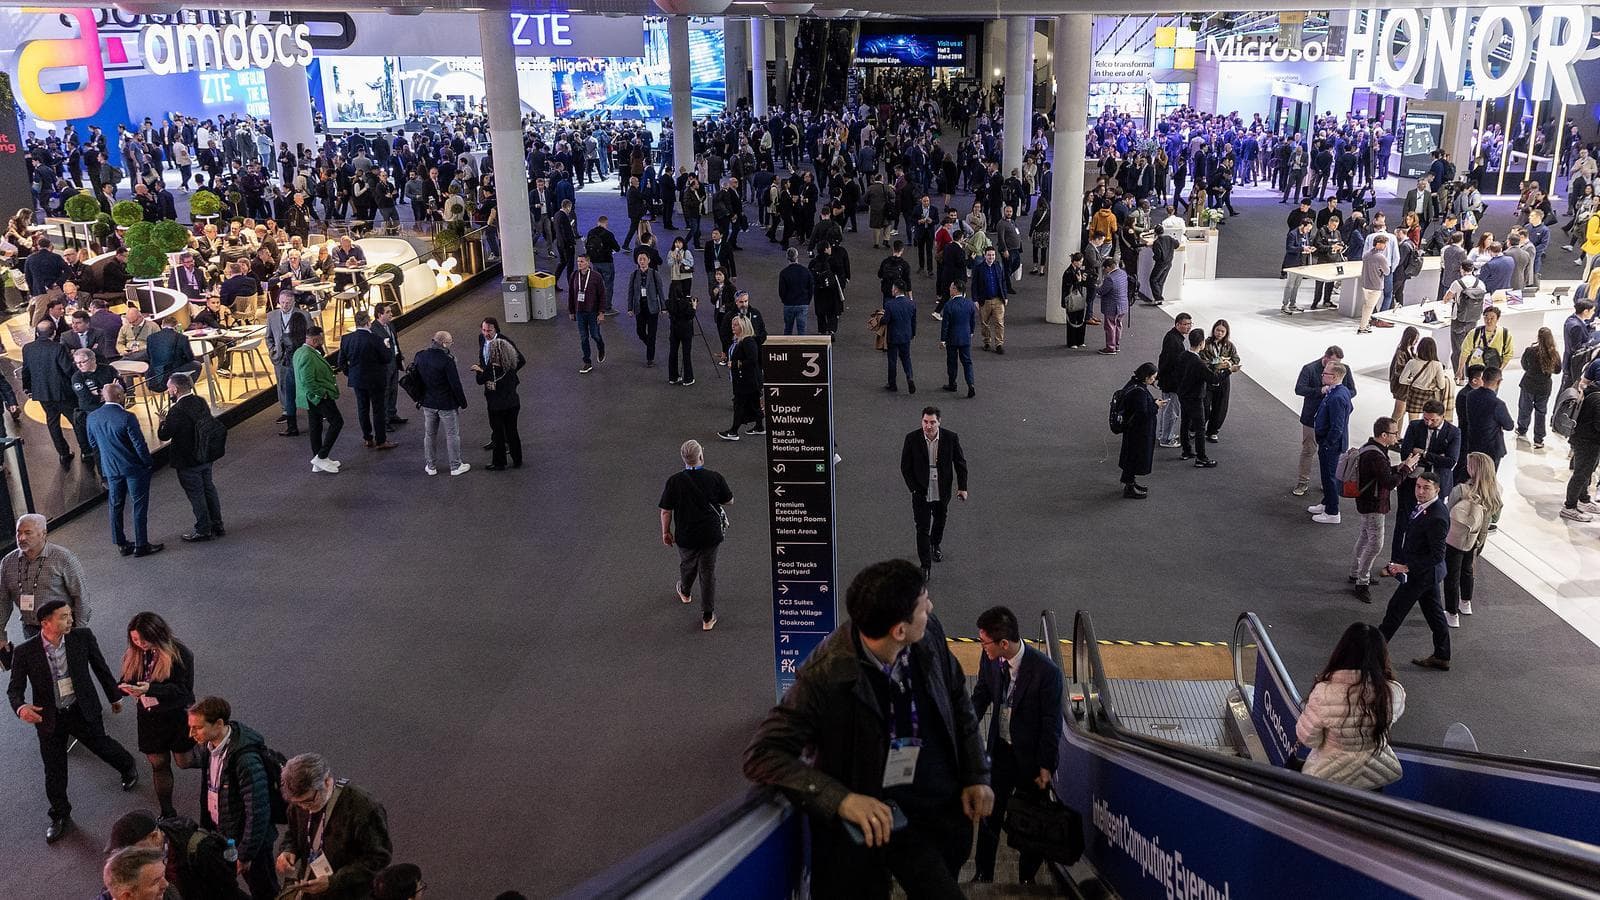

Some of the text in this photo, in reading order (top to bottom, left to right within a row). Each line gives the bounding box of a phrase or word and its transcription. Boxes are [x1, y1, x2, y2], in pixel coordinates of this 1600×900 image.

[511, 13, 573, 45] ZTE
[144, 11, 313, 75] amdocs
[1345, 5, 1584, 104] HONOR
[1094, 69, 1101, 77] in
[1102, 69, 1113, 77] the
[1127, 69, 1135, 77] of
[199, 73, 234, 103] ZTE
[769, 352, 820, 378] Hall 3
[771, 404, 802, 414] Upper
[771, 415, 814, 425] Walkway
[777, 568, 811, 576] Courtyard
[800, 609, 823, 617] Village
[781, 658, 795, 667] 4Y
[1092, 792, 1125, 849] Intelligent
[1123, 815, 1175, 900] Computing
